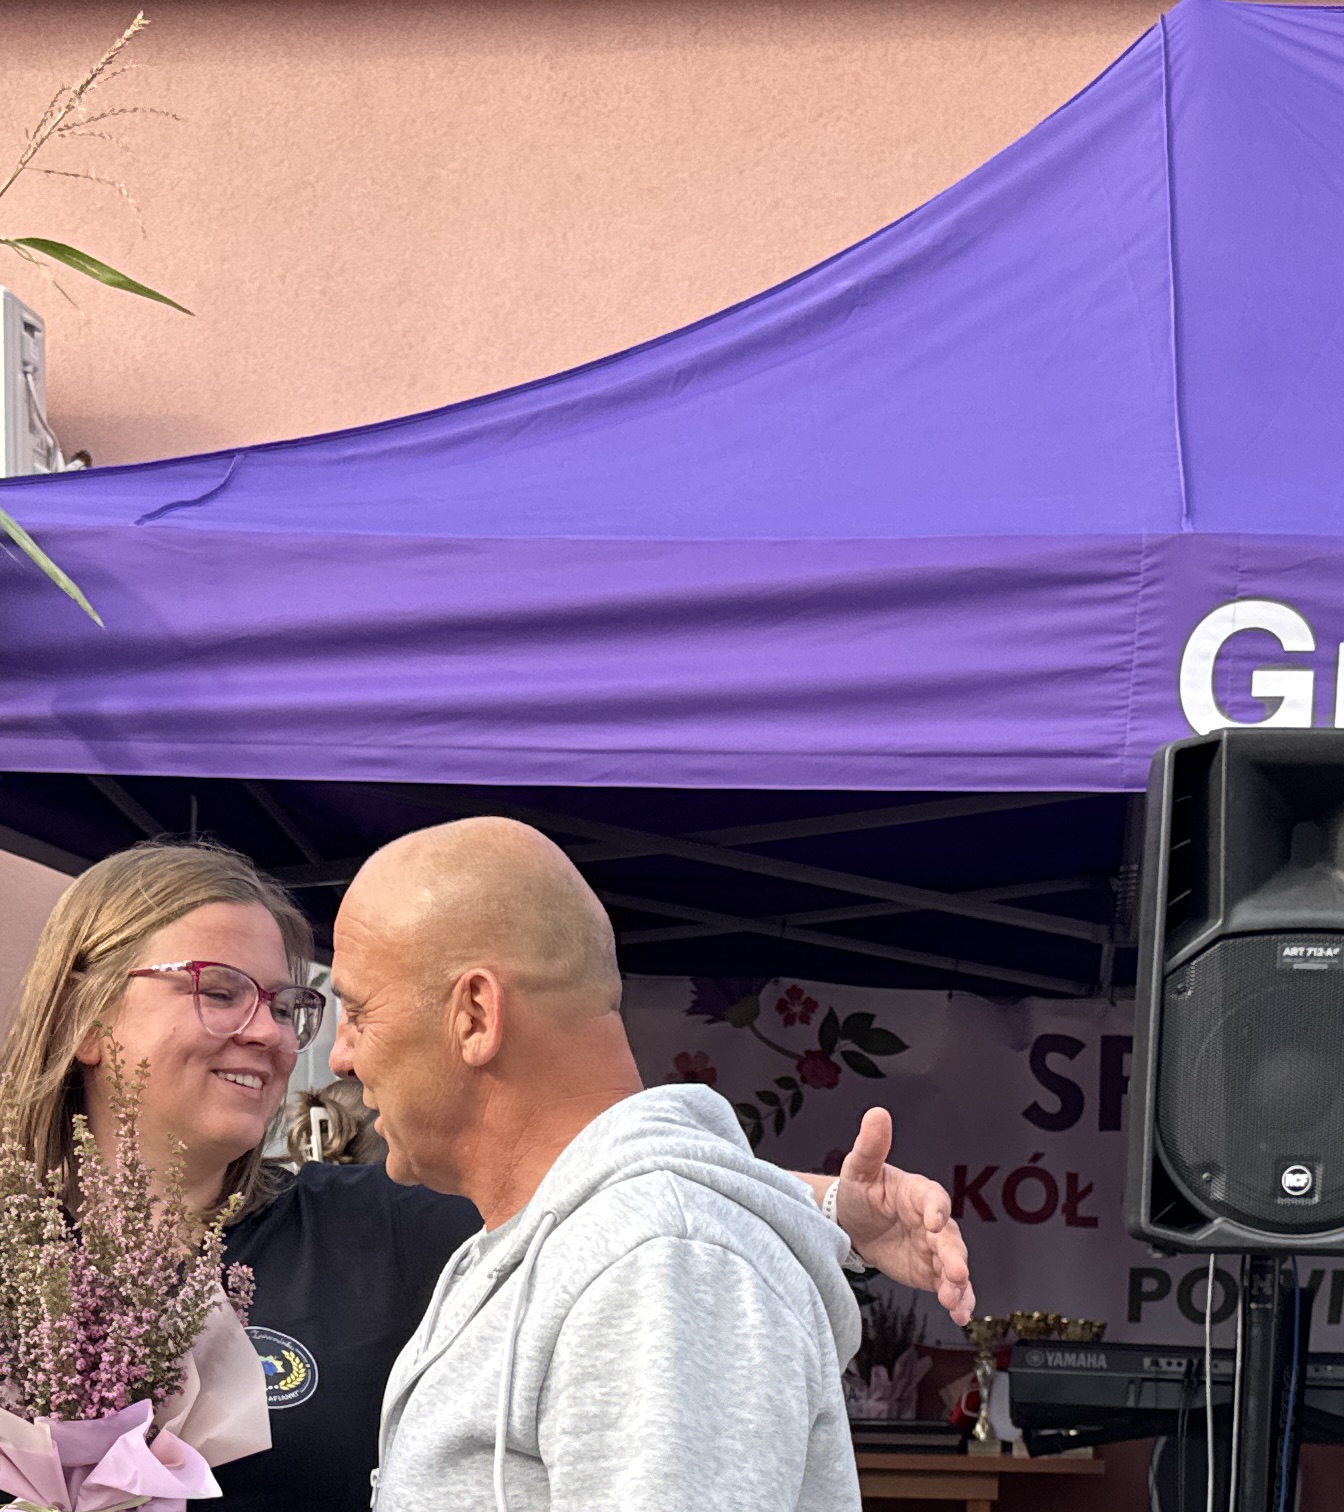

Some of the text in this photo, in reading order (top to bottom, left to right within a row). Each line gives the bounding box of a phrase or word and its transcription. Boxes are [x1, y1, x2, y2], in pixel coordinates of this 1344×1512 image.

[1282, 946, 1305, 957] ART
[1285, 1173, 1309, 1187] RCF
[955, 1152, 1099, 1229] KÓŁ
[1045, 1353, 1106, 1369] YAMAHA
